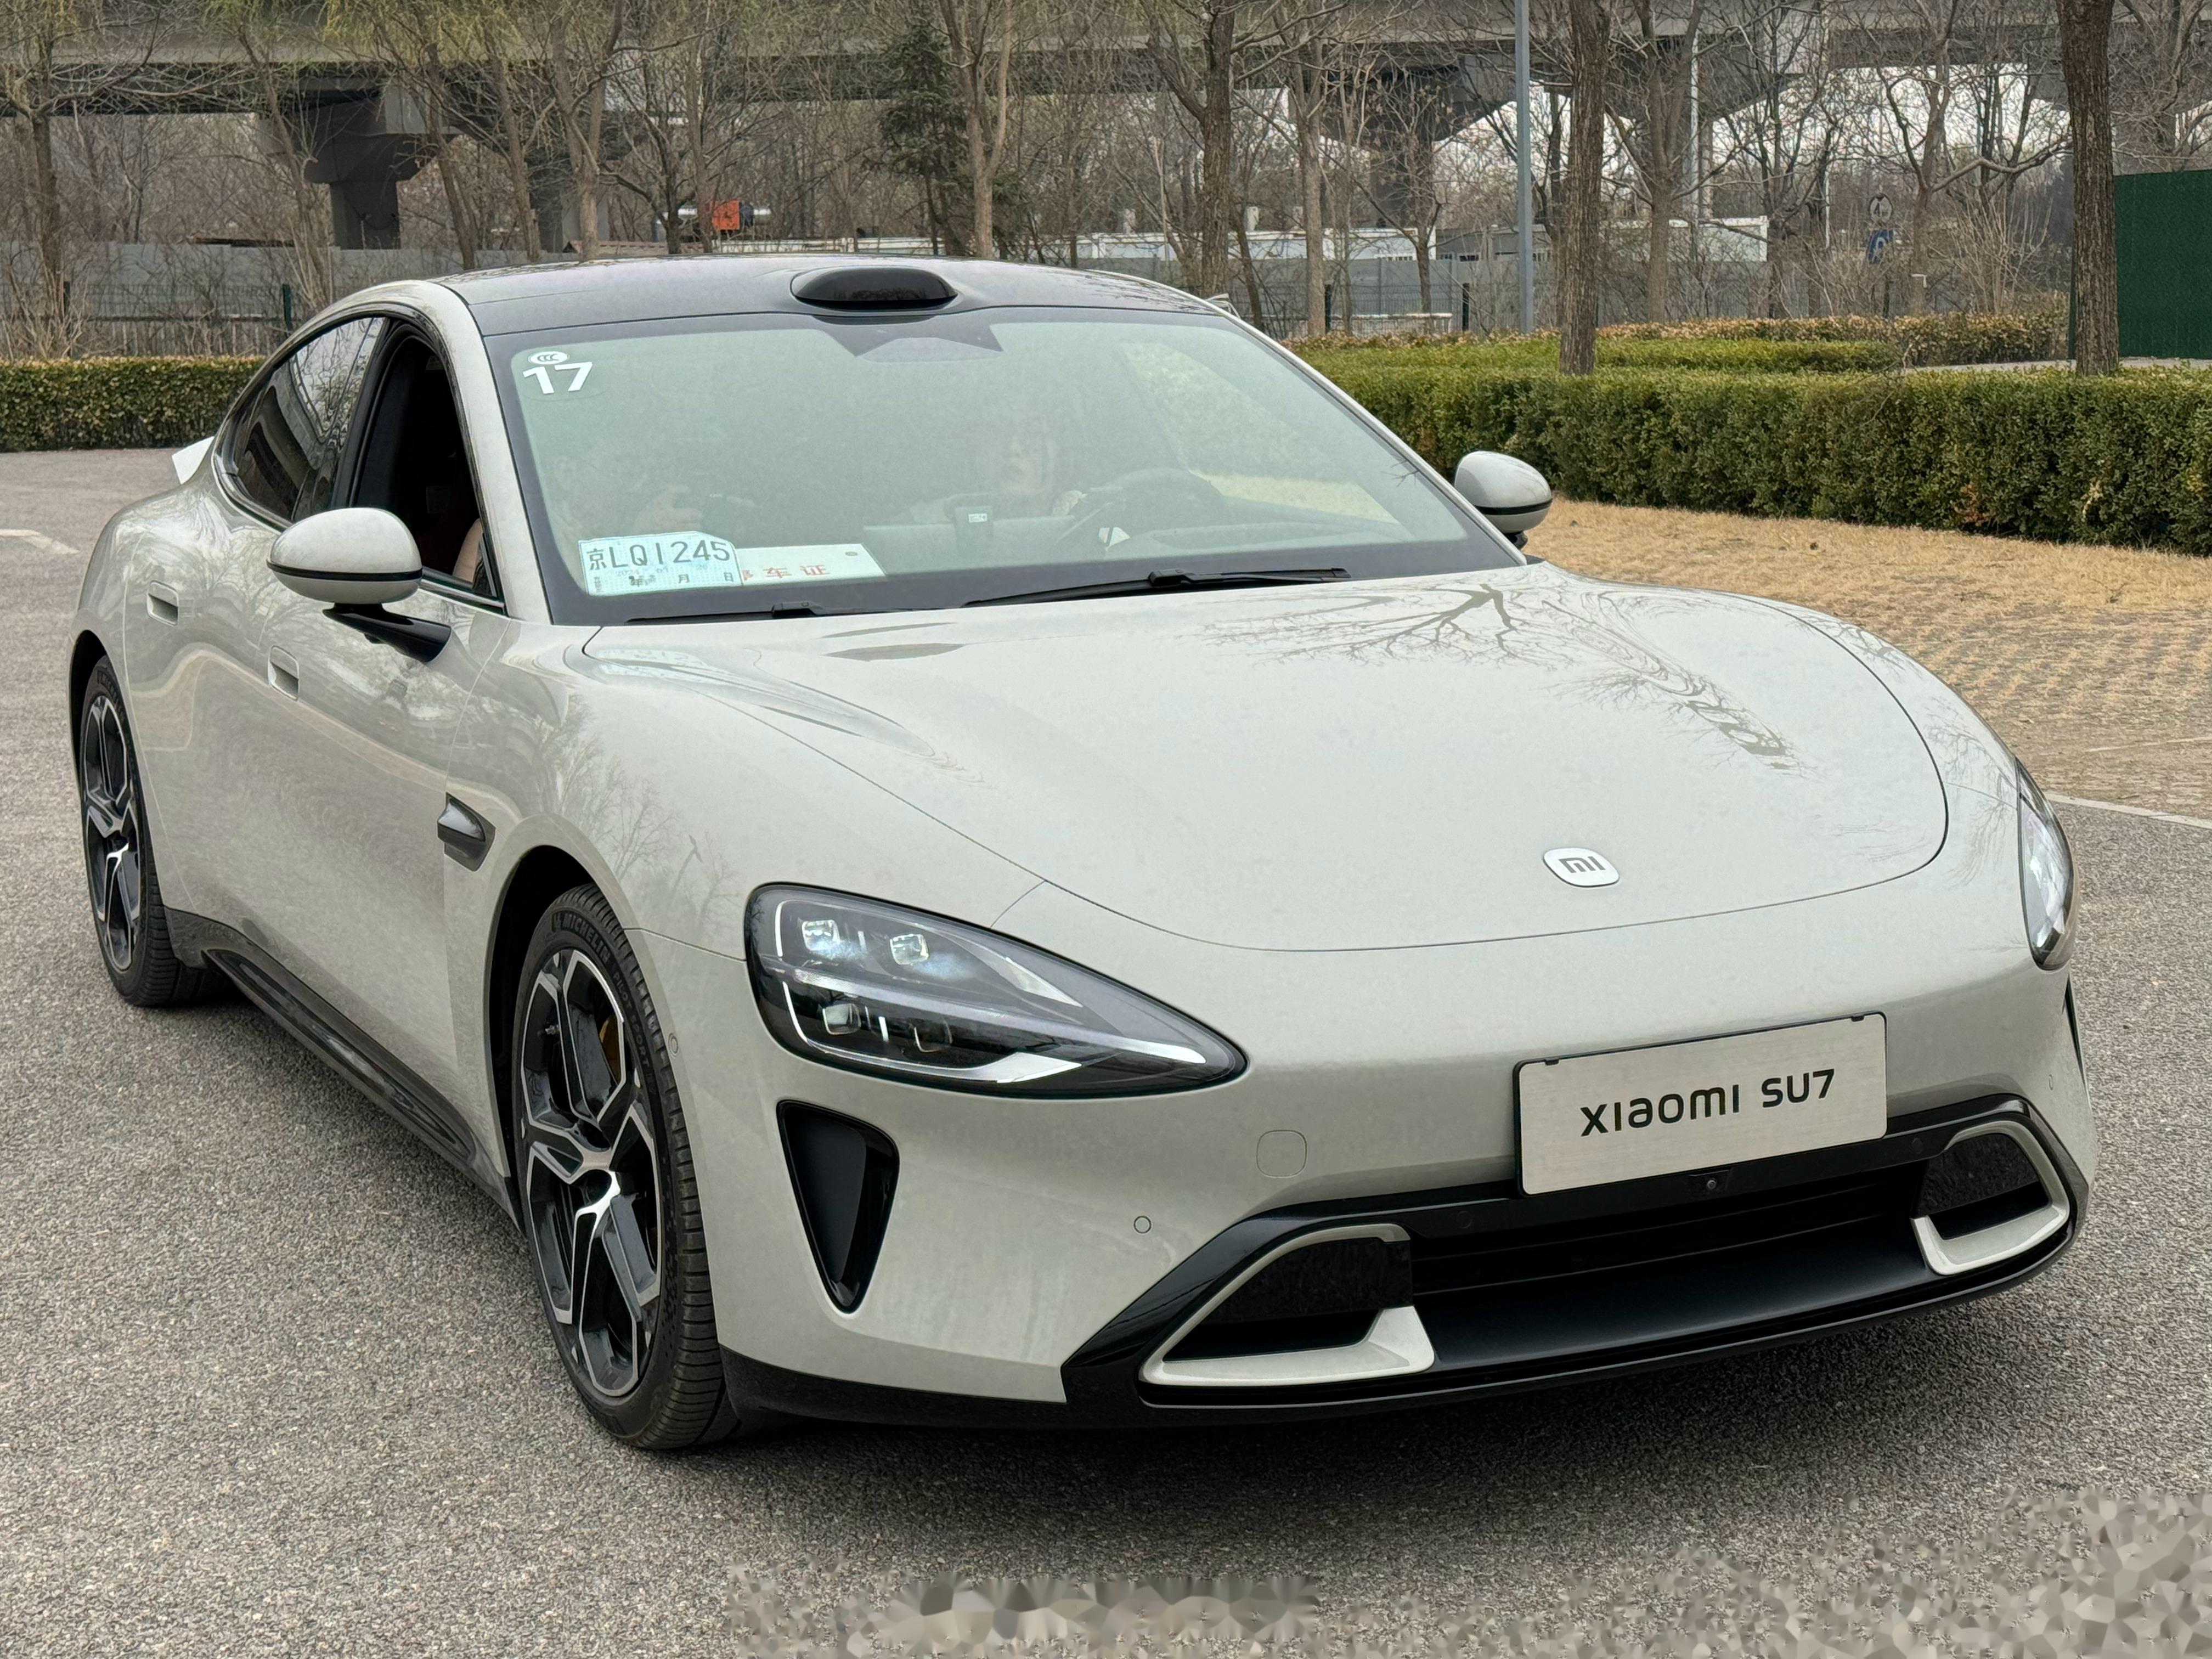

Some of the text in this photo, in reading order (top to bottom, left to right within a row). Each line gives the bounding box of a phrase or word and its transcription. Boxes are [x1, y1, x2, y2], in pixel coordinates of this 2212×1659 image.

[523, 362, 593, 394] 17
[586, 539, 730, 571] 京LQ1245
[678, 574, 690, 584] 月
[724, 572, 734, 582] 日
[562, 913, 611, 965] MICHELIN
[613, 972, 633, 1009] PILOT
[630, 1014, 650, 1069] SPORT
[1761, 1068, 1835, 1108] SU7
